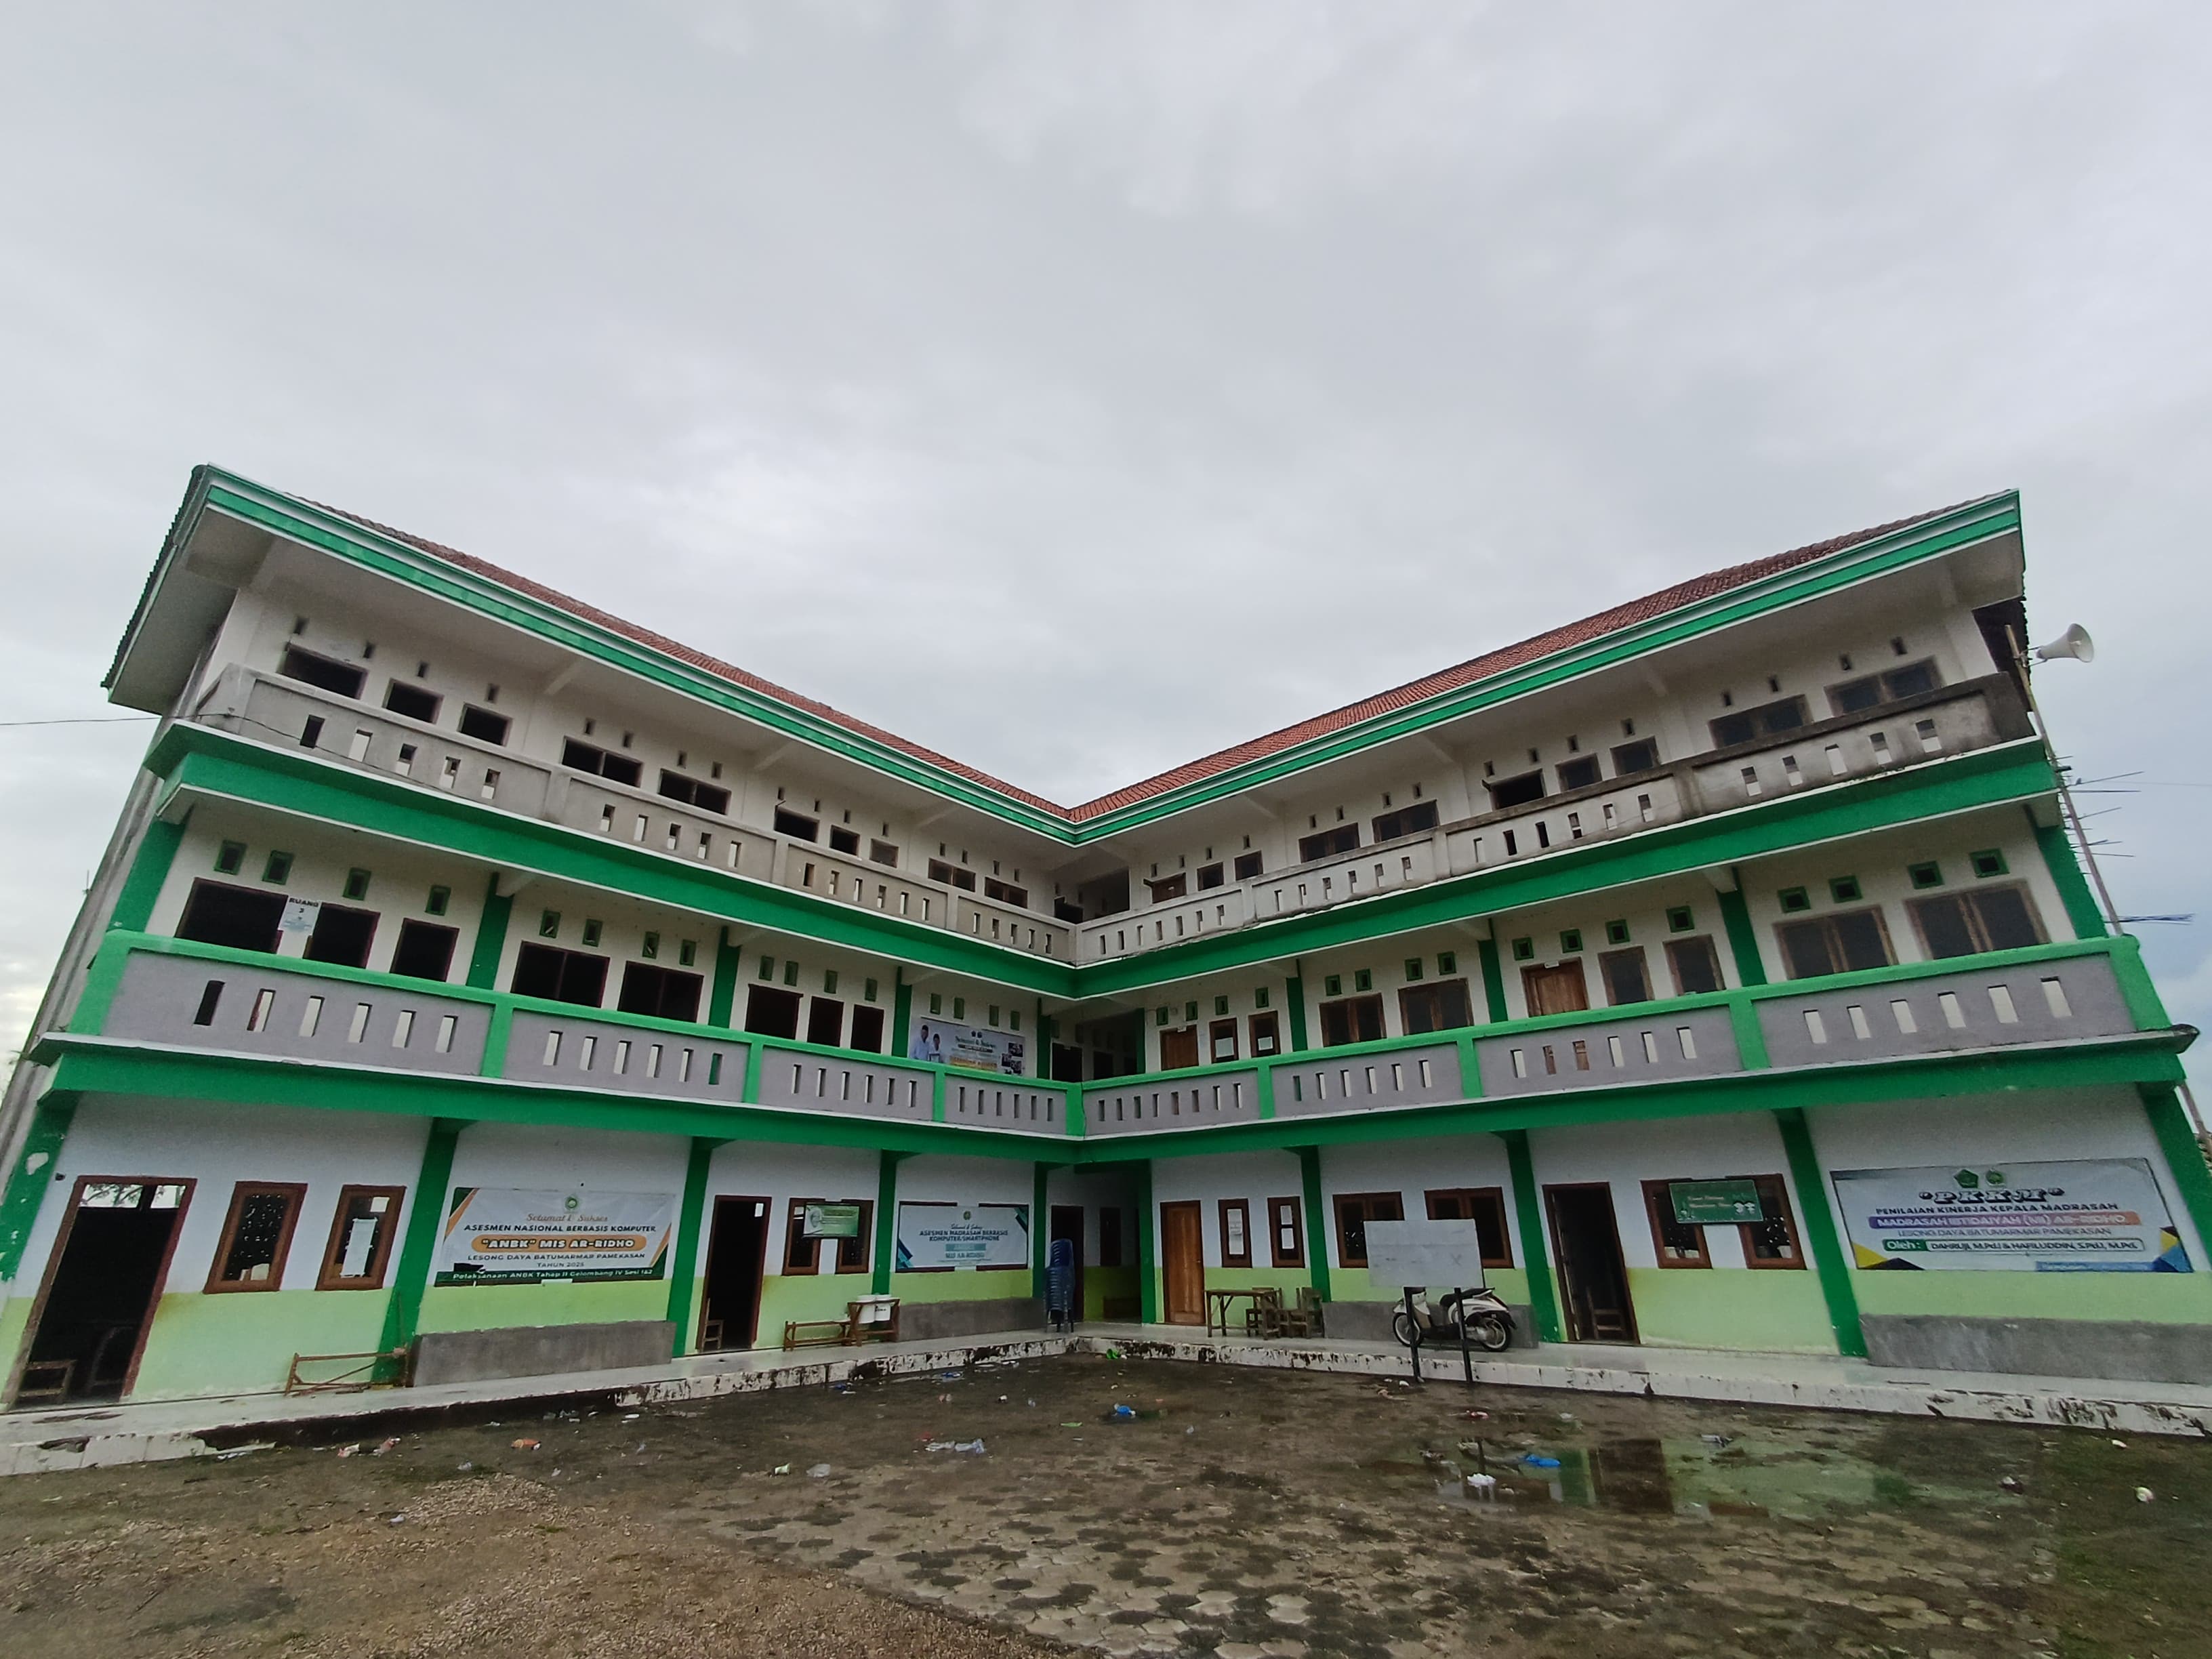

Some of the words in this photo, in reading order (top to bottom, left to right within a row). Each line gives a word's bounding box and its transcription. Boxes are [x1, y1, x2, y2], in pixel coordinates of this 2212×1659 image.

[1990, 1204, 2038, 1212] KEPALA
[2040, 1202, 2118, 1211] MADRASAH
[1877, 1218, 1947, 1227] MADRASAH
[1938, 1229, 1966, 1237] DAYA
[482, 1238, 537, 1249] "ANBK"
[539, 1239, 567, 1249] MIS
[569, 1239, 635, 1249] AR-RIDHO
